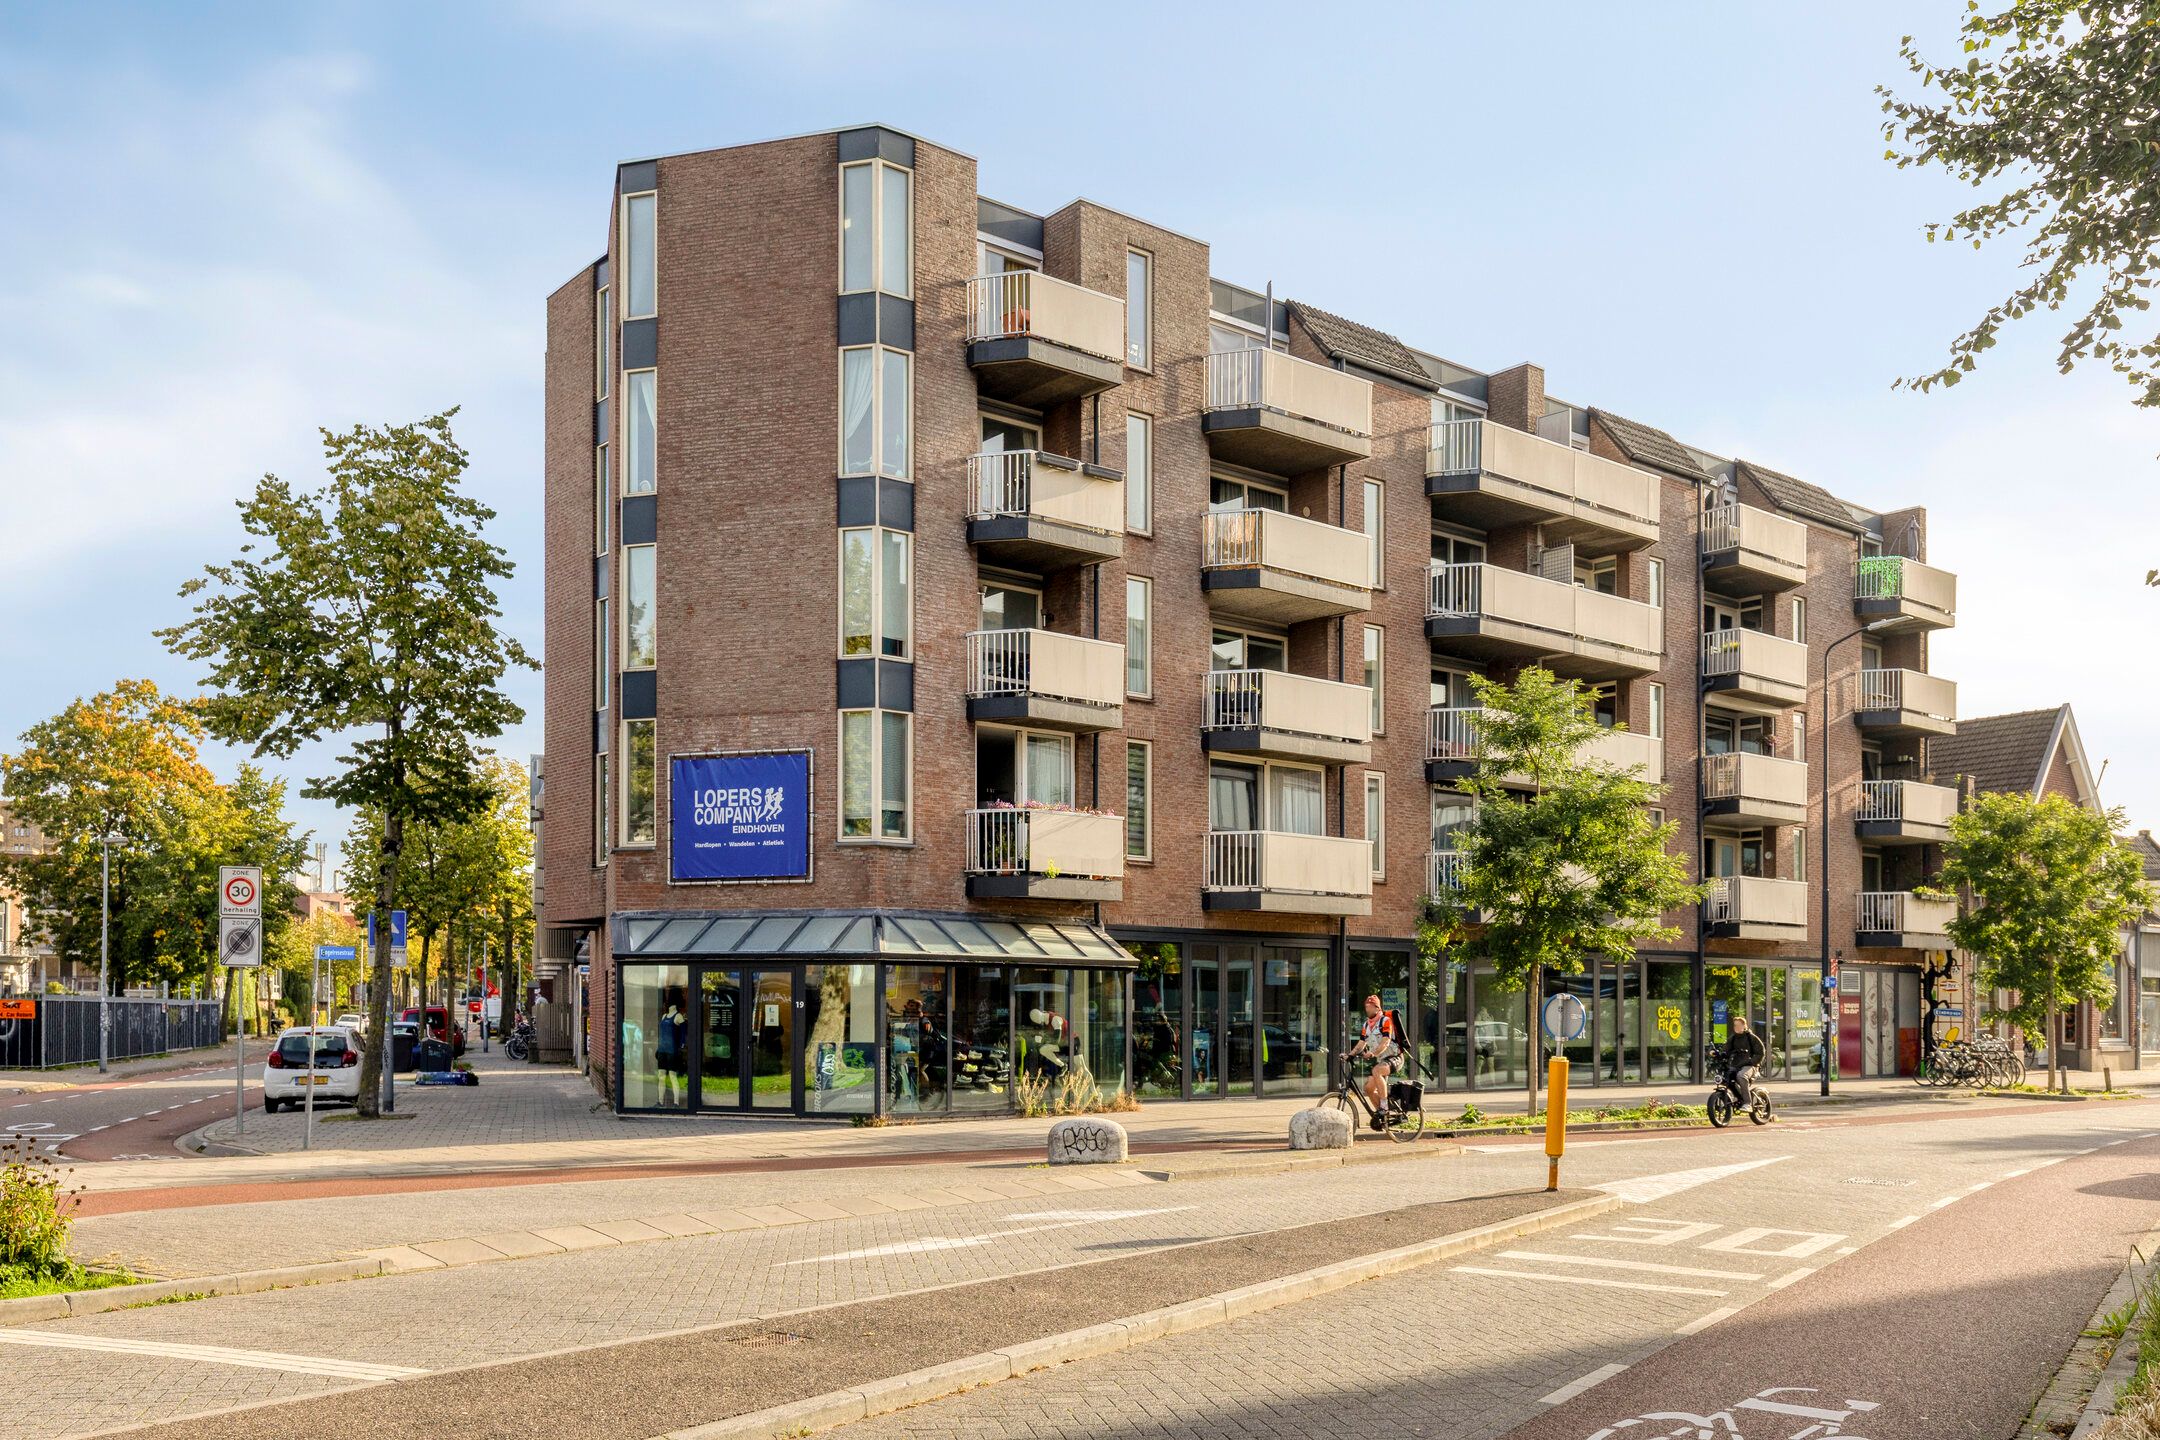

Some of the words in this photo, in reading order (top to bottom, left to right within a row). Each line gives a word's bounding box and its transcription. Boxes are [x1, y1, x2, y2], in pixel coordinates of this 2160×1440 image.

[694, 787, 762, 808] LOPERS
[694, 806, 762, 825] COMPANY
[732, 824, 785, 834] EINDHOVEN
[231, 886, 251, 897] 30
[795, 1001, 805, 1009] 19
[1657, 1006, 1681, 1019] Circle
[1796, 1008, 1808, 1018] the
[1657, 1018, 1669, 1031] Fit
[813, 1073, 822, 1112] BROOKS
